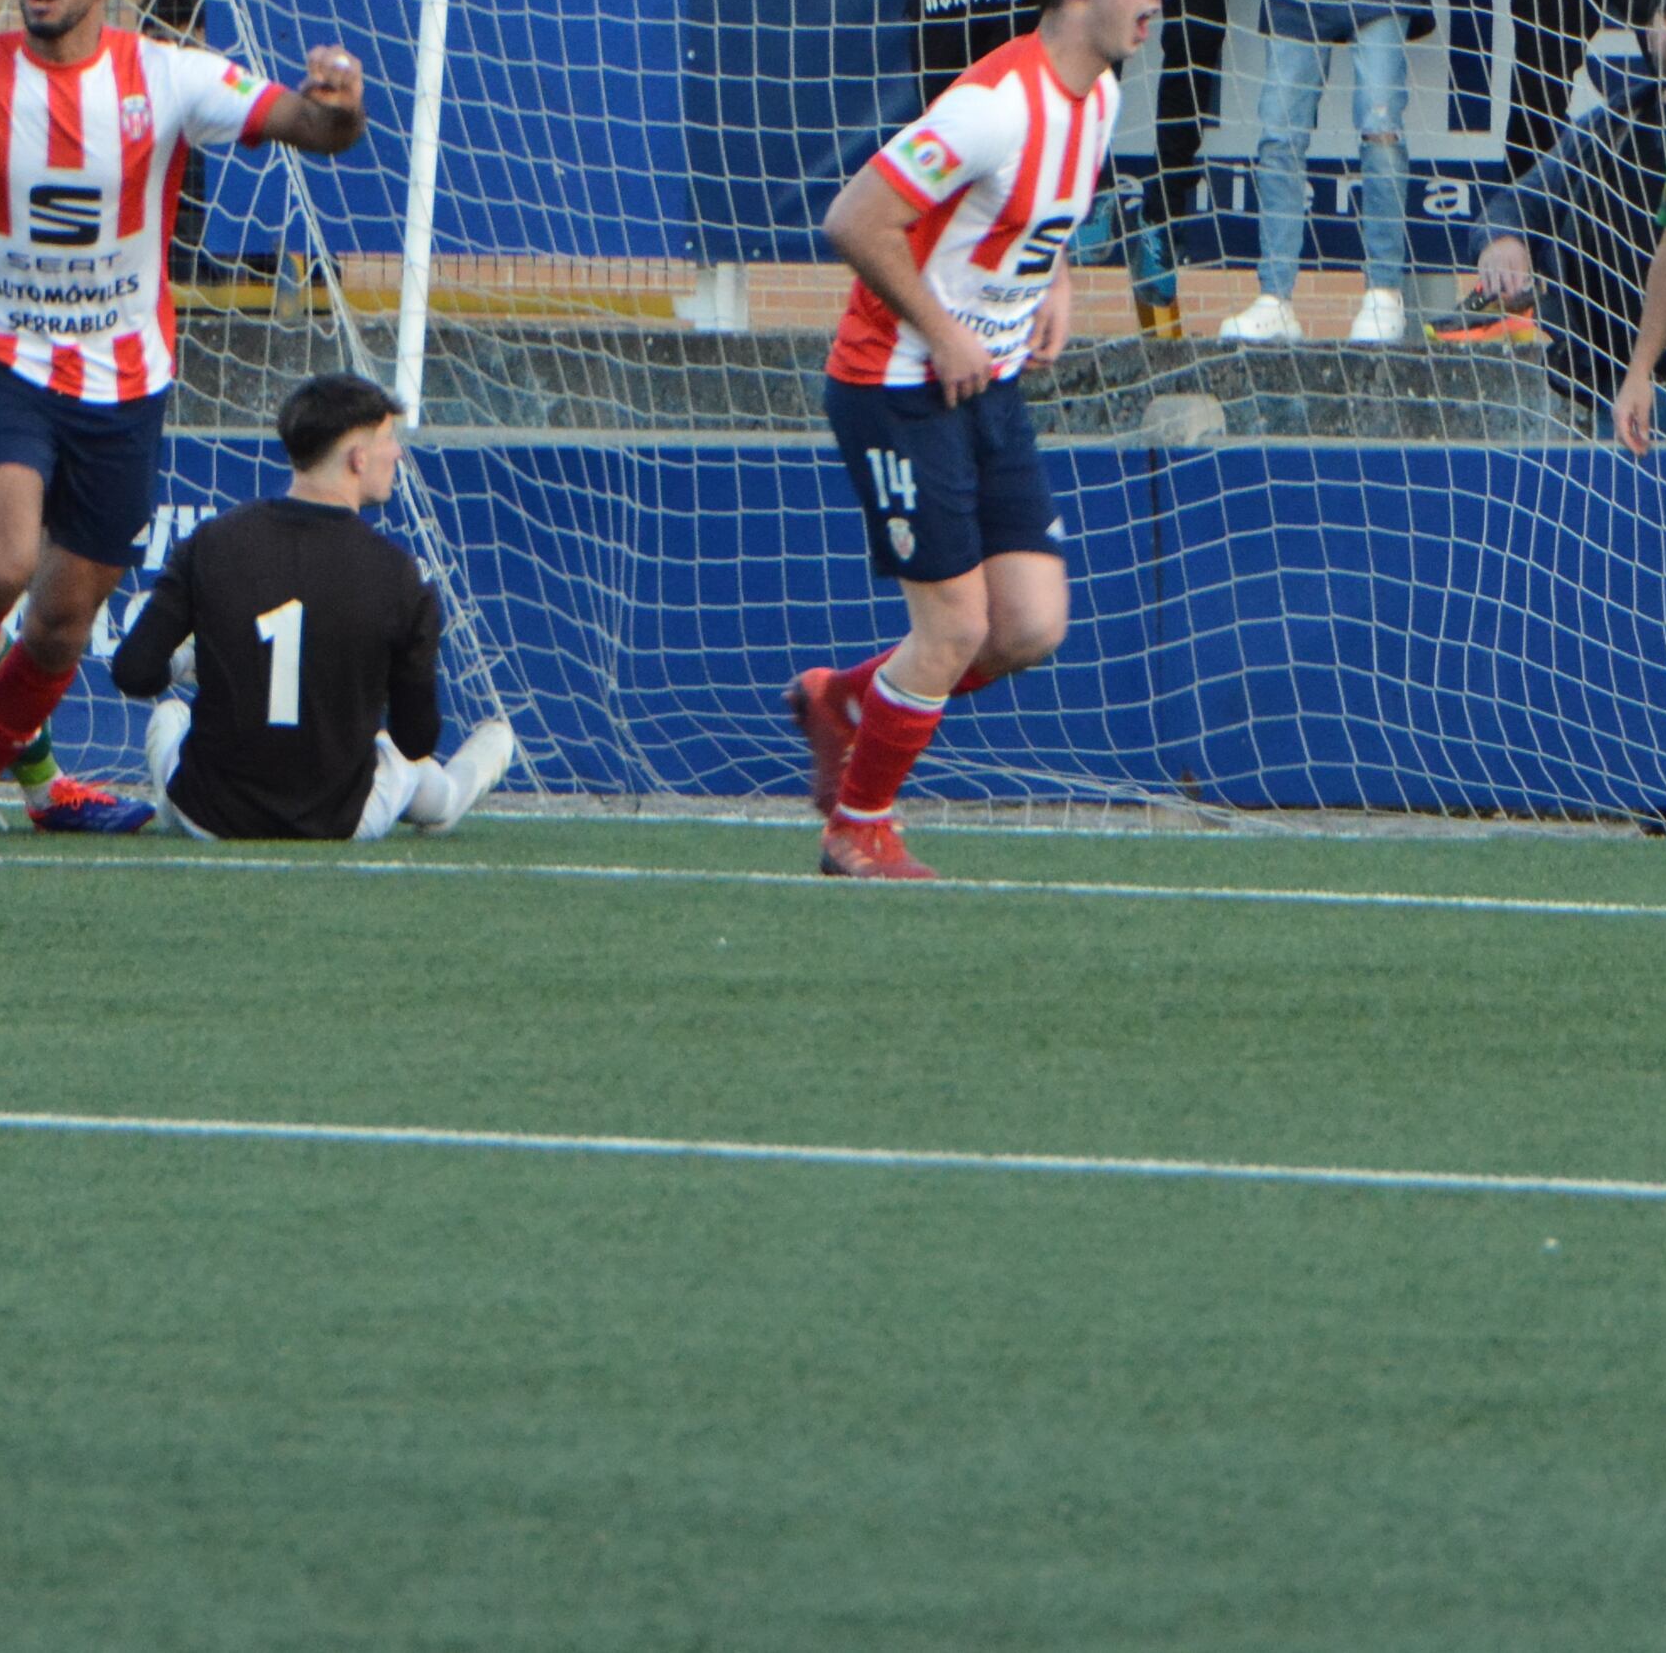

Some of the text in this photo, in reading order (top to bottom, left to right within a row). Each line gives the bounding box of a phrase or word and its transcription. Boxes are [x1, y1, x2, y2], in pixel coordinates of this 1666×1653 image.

[6, 250, 122, 274] SEAT
[8, 309, 119, 335] SERRABLO
[866, 448, 918, 510] 14
[255, 597, 304, 726] 1
